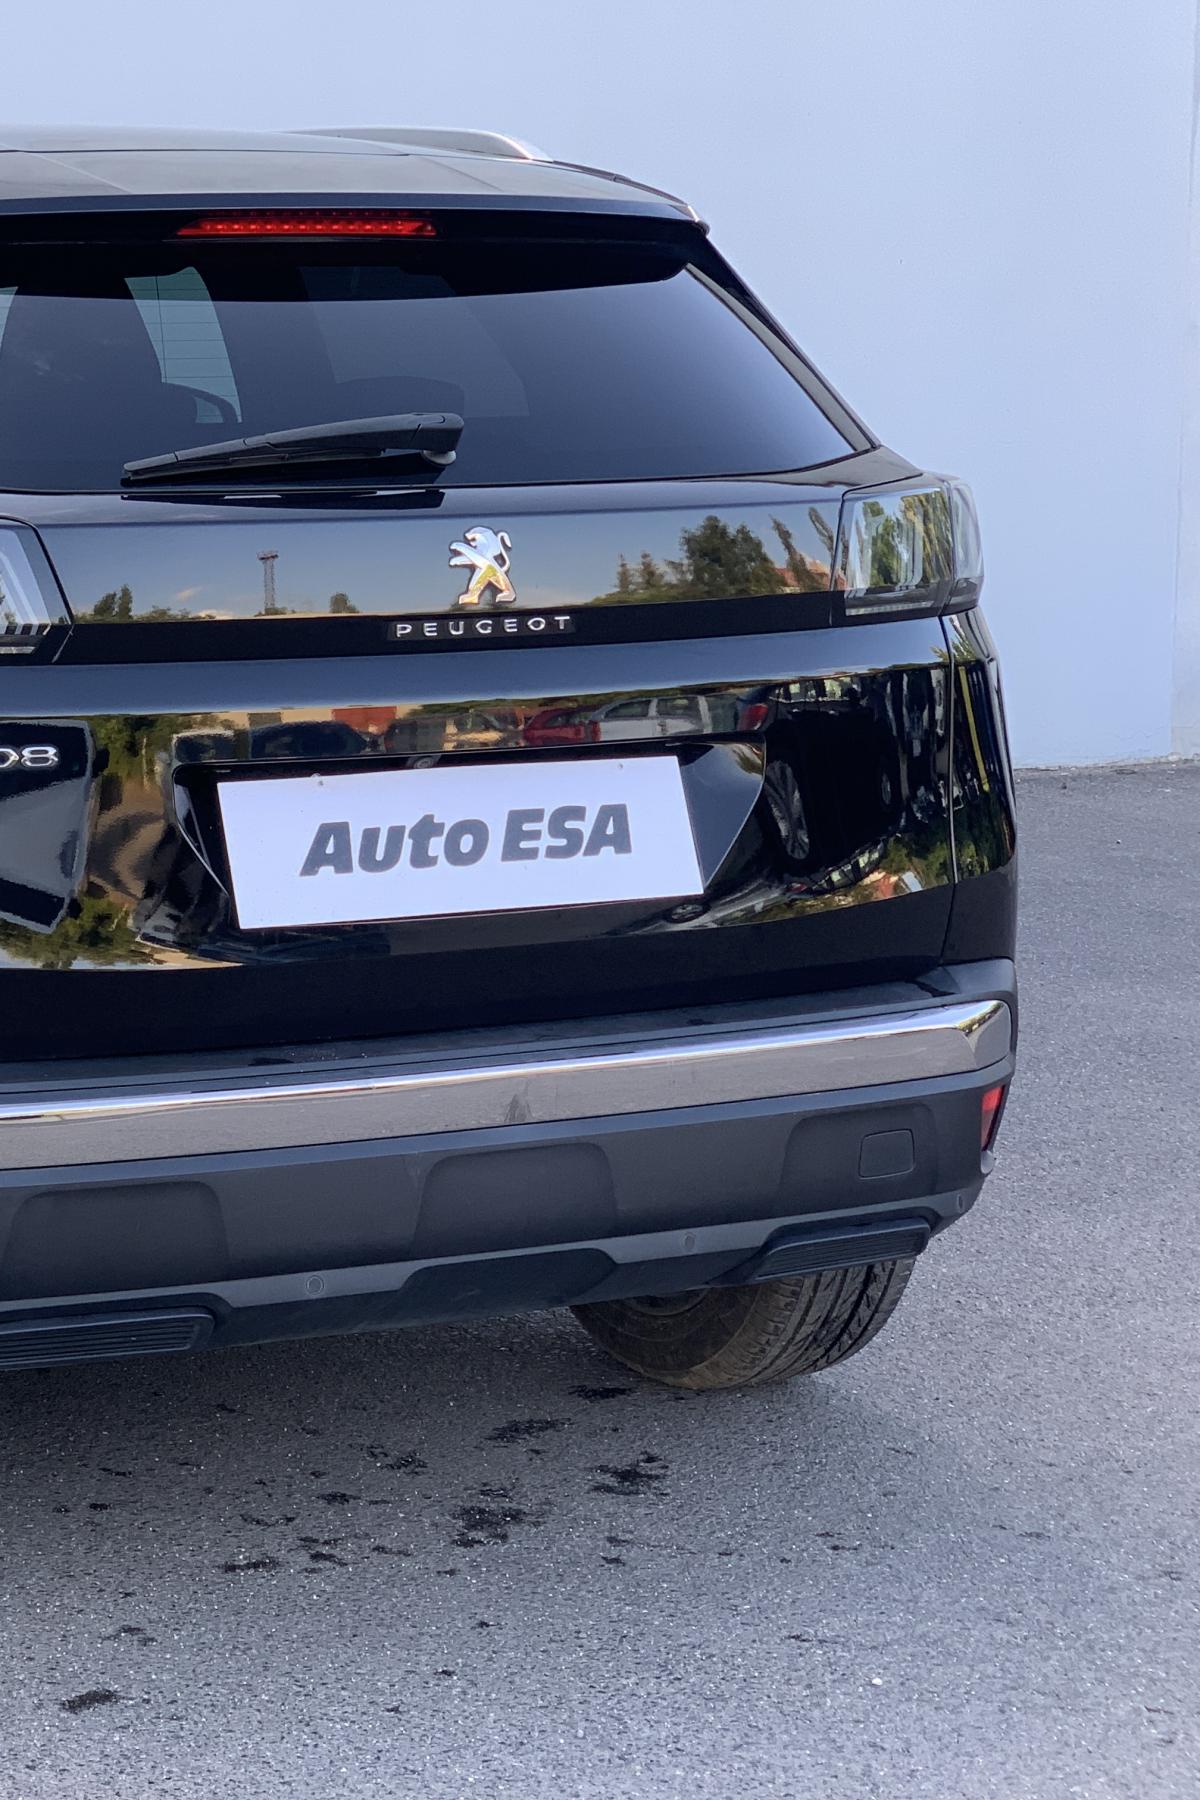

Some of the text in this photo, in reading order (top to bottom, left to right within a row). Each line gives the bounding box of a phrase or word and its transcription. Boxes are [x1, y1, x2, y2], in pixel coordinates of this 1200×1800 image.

[395, 615, 571, 638] PEUGEOT
[299, 803, 633, 877] Auto ESA
